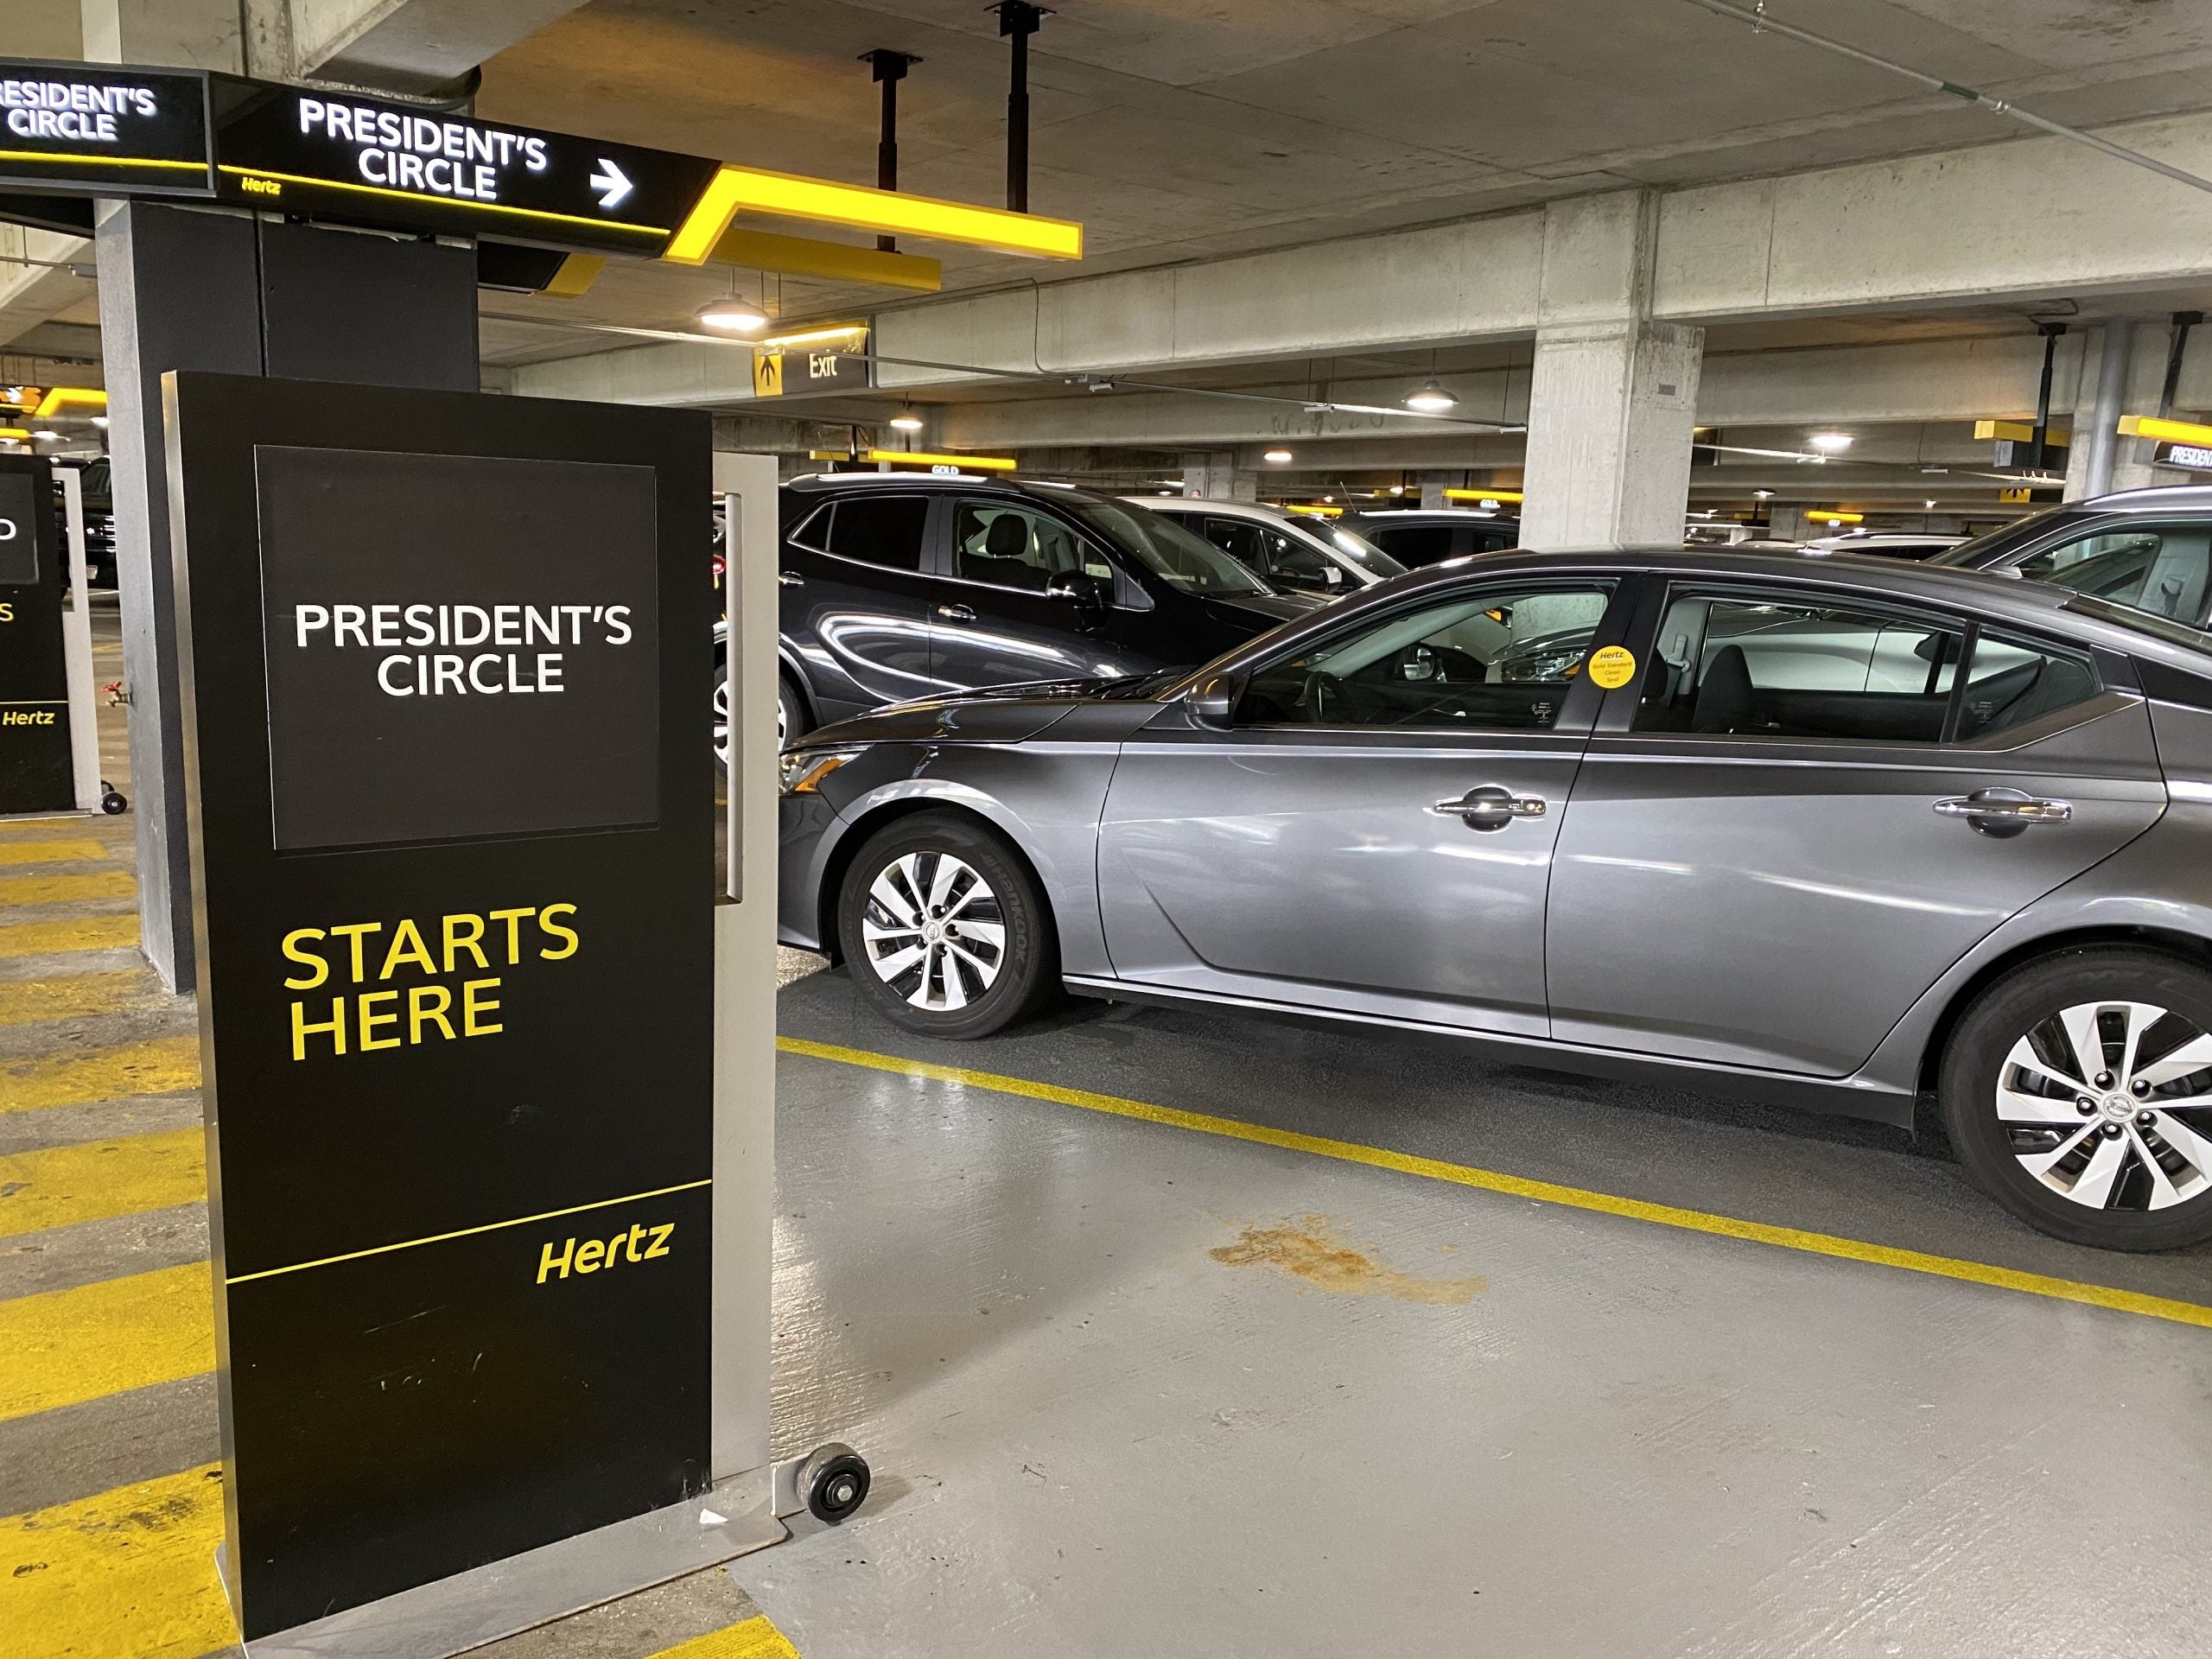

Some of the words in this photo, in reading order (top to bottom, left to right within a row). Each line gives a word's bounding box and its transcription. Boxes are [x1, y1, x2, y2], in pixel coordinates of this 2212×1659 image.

[8, 109, 118, 141] CIRCLE
[299, 98, 548, 170] PRESIDENT'S
[242, 176, 282, 195] Hertz
[359, 148, 498, 200] CIRCLE
[809, 353, 837, 378] Exit
[931, 464, 959, 474] GOLD
[296, 604, 632, 647] PRESIDENT'S
[378, 653, 564, 696] CIRCLE
[1600, 651, 1624, 659] Hertz
[3, 711, 55, 726] Hertz
[282, 903, 579, 990] STARTS
[291, 977, 503, 1061] HERE
[536, 1223, 676, 1284] Hertz
